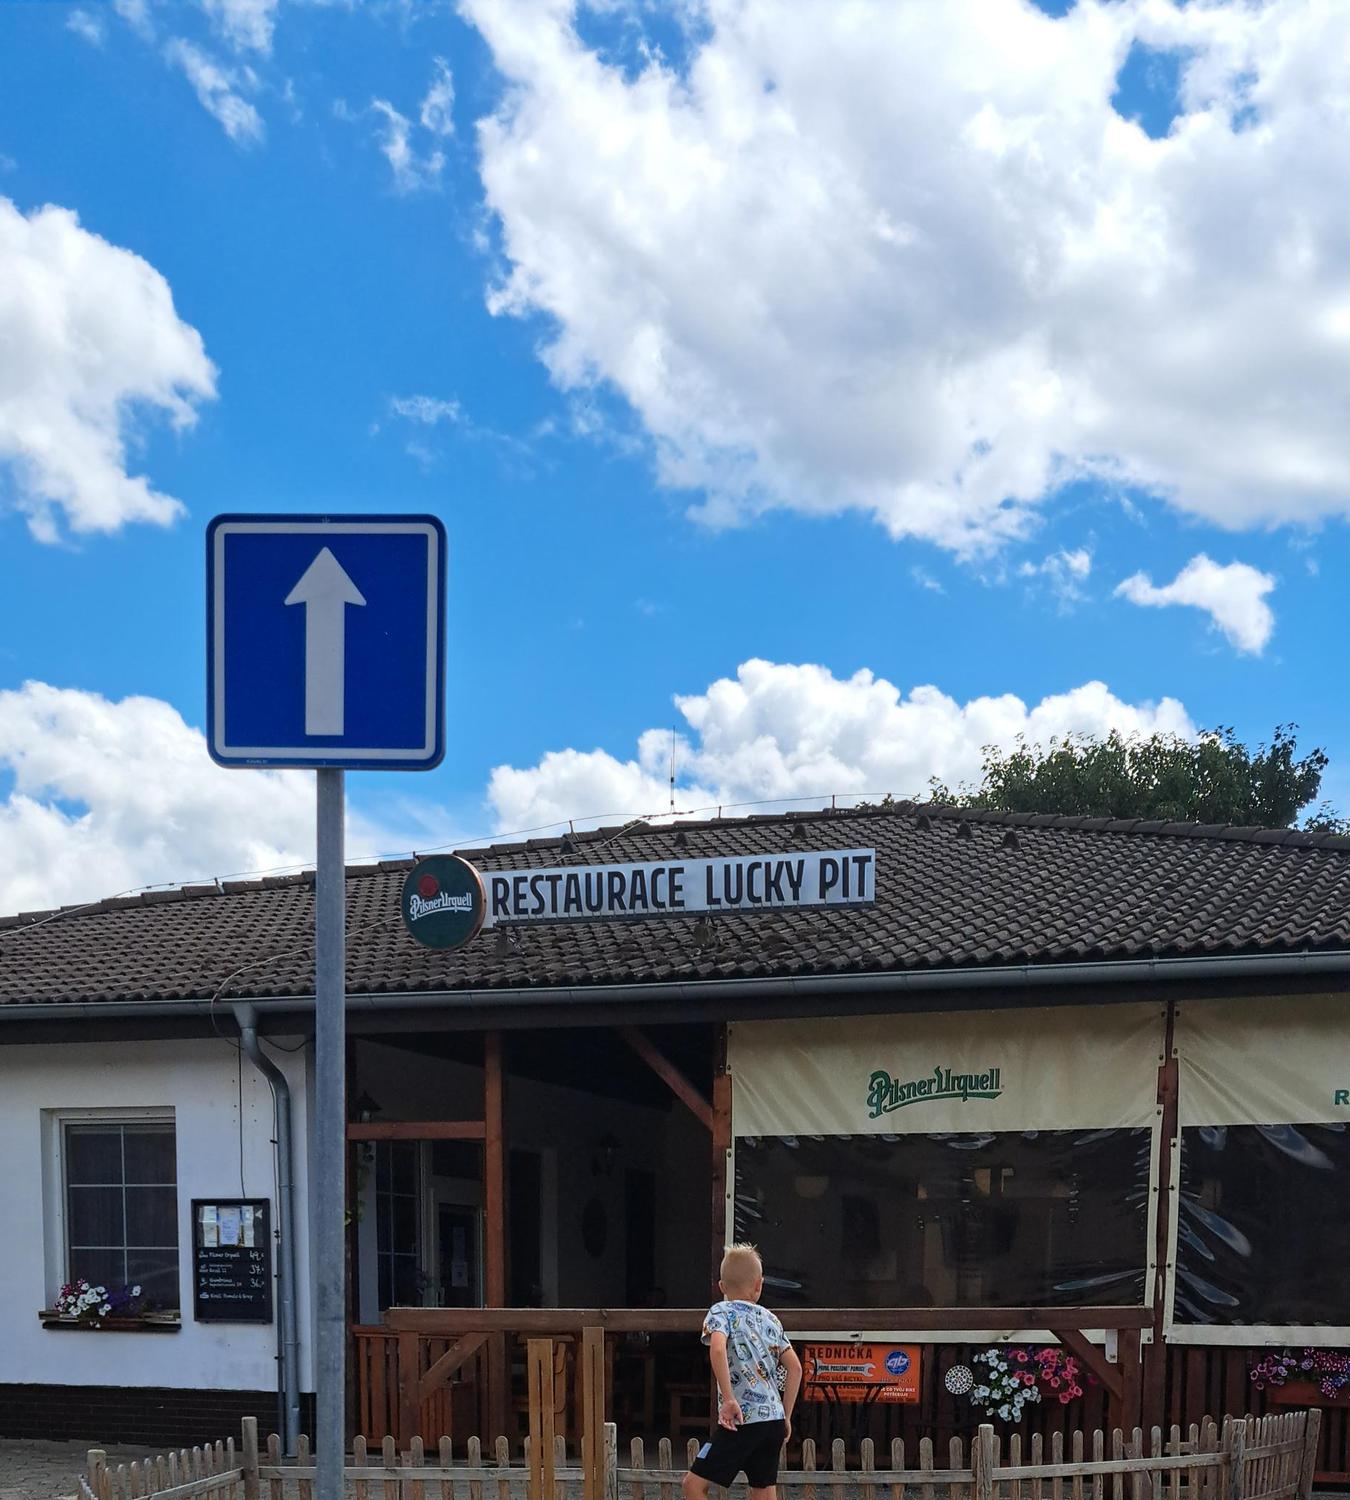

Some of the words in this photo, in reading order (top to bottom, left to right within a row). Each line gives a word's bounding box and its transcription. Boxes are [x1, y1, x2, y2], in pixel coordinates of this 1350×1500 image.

[410, 894, 441, 921] Pilsner
[440, 891, 472, 913] Urquell
[492, 867, 685, 916] RESTAURACE
[706, 859, 805, 905] LUCKY
[819, 855, 872, 899] PIT
[867, 1070, 936, 1119] Pilsner
[934, 1066, 1001, 1102] Urquell
[809, 1346, 873, 1359] BEDNIČKA
